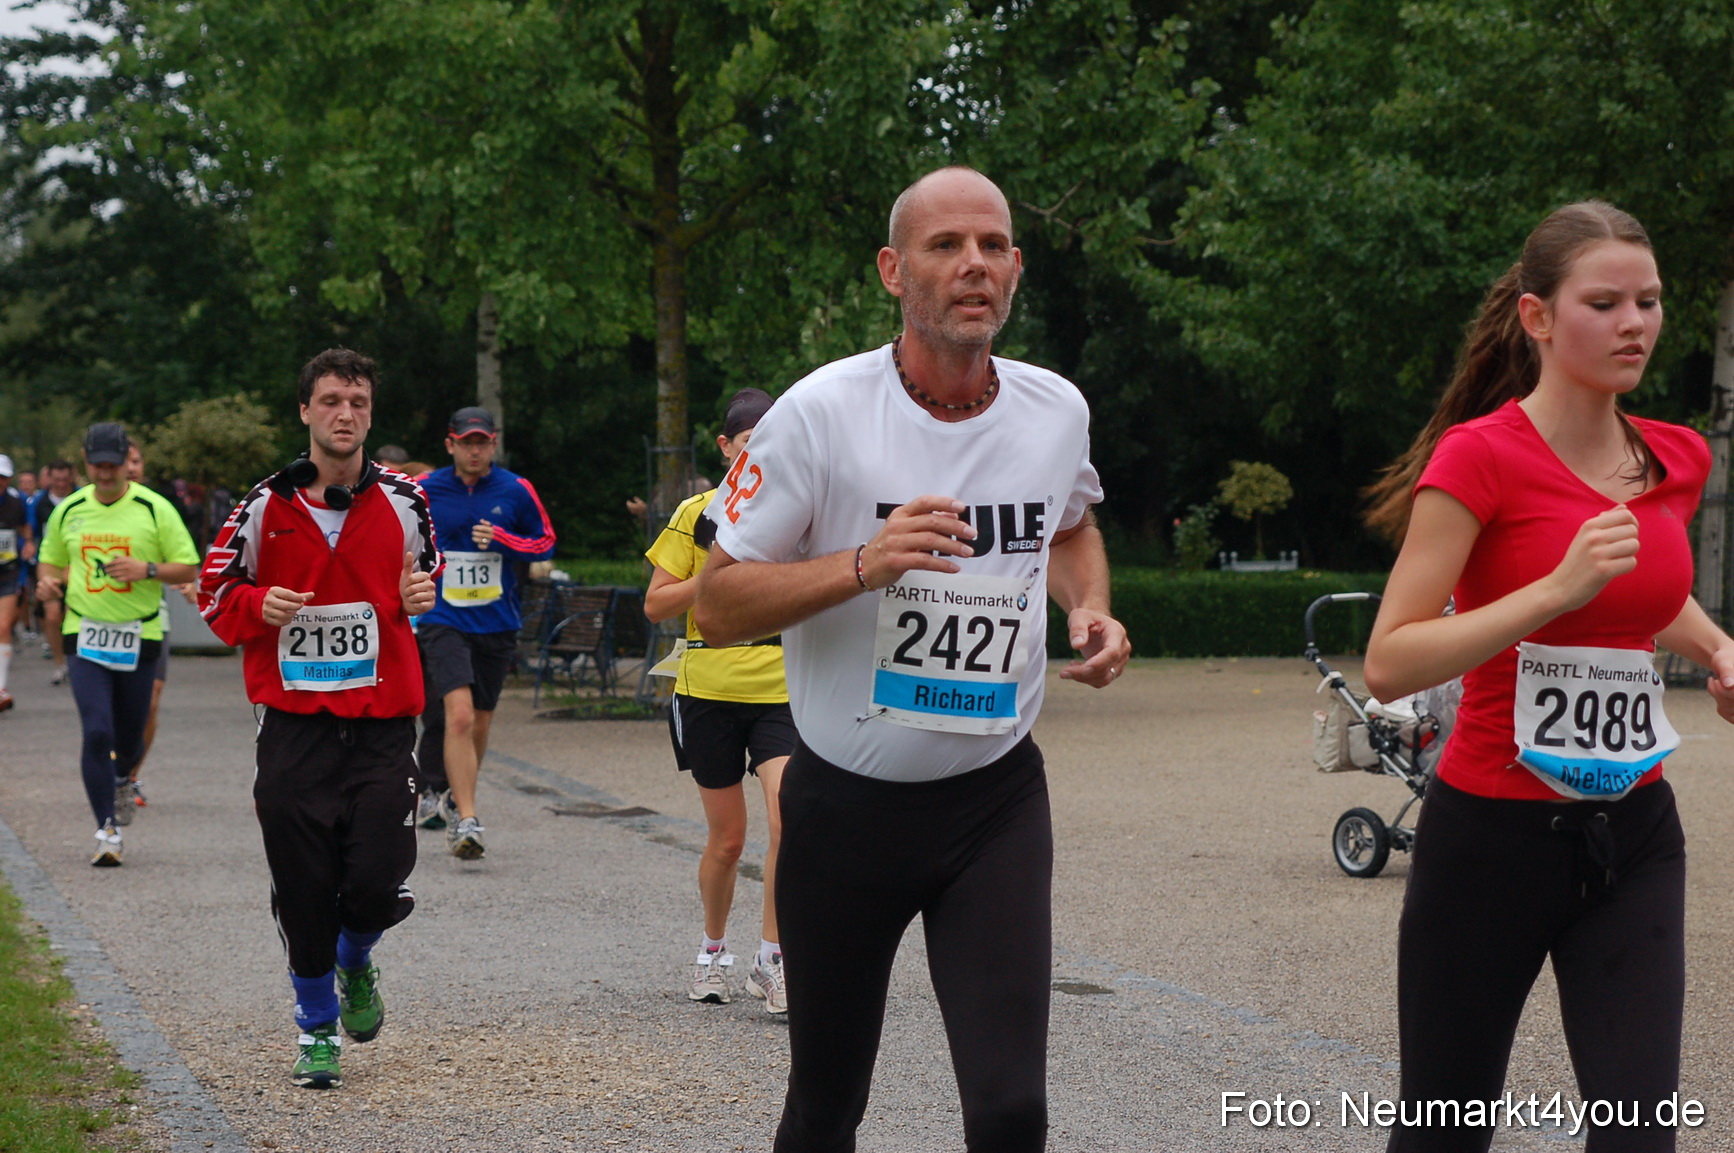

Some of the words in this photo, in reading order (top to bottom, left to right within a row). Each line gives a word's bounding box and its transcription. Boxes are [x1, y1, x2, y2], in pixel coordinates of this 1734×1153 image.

[724, 450, 763, 525] 42
[876, 501, 1045, 558] ULE
[1007, 539, 1042, 551] SWEDEN
[456, 565, 489, 585] 113
[885, 584, 940, 604] PARTL
[943, 591, 1014, 609] Neumarkt
[314, 612, 360, 623] Neumarkt
[86, 627, 134, 649] 2070
[288, 624, 369, 657] 2138
[892, 610, 1021, 674] 2427
[303, 666, 353, 679] Mathias
[1521, 659, 1583, 679] PARTL
[1588, 665, 1648, 683] Neumarkt
[914, 684, 996, 713] Richard
[1534, 687, 1657, 753] 2989
